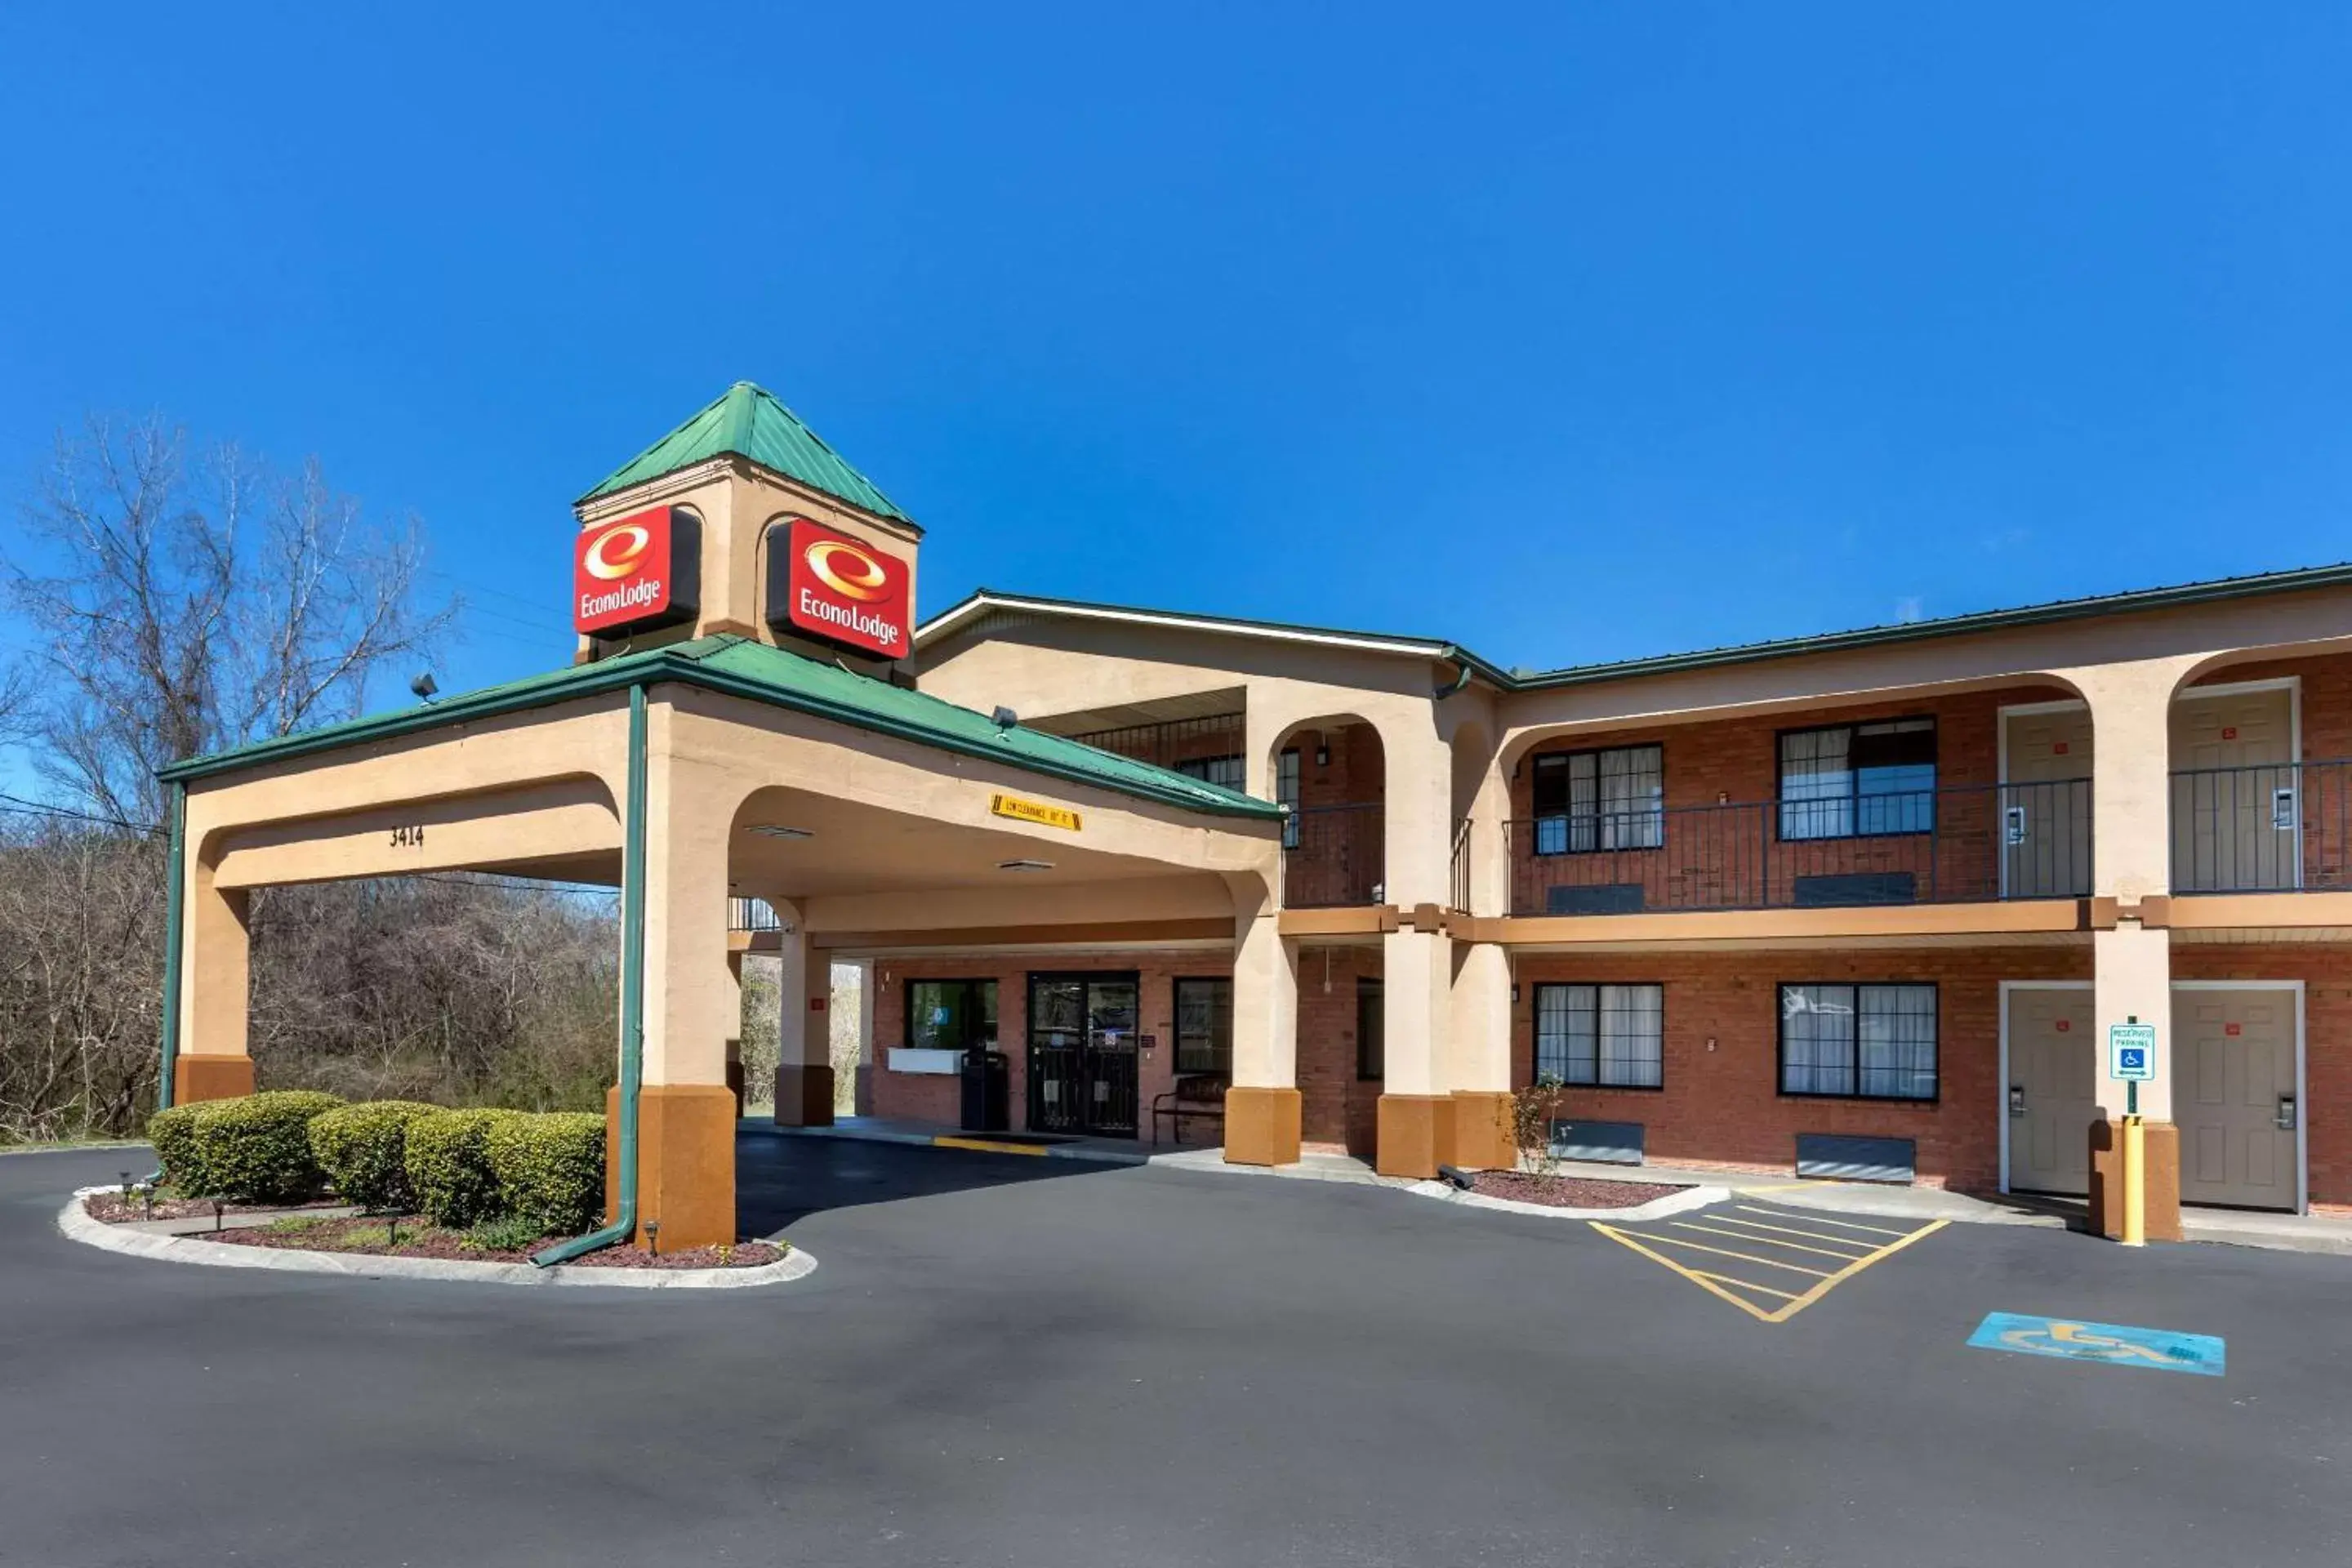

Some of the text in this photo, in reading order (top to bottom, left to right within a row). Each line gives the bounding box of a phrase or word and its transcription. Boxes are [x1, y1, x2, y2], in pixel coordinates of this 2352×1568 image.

[581, 579, 661, 619] EconoLodge
[800, 588, 899, 646] EconoLodge
[1018, 803, 1046, 818] CLENCE
[390, 824, 424, 847] 3414
